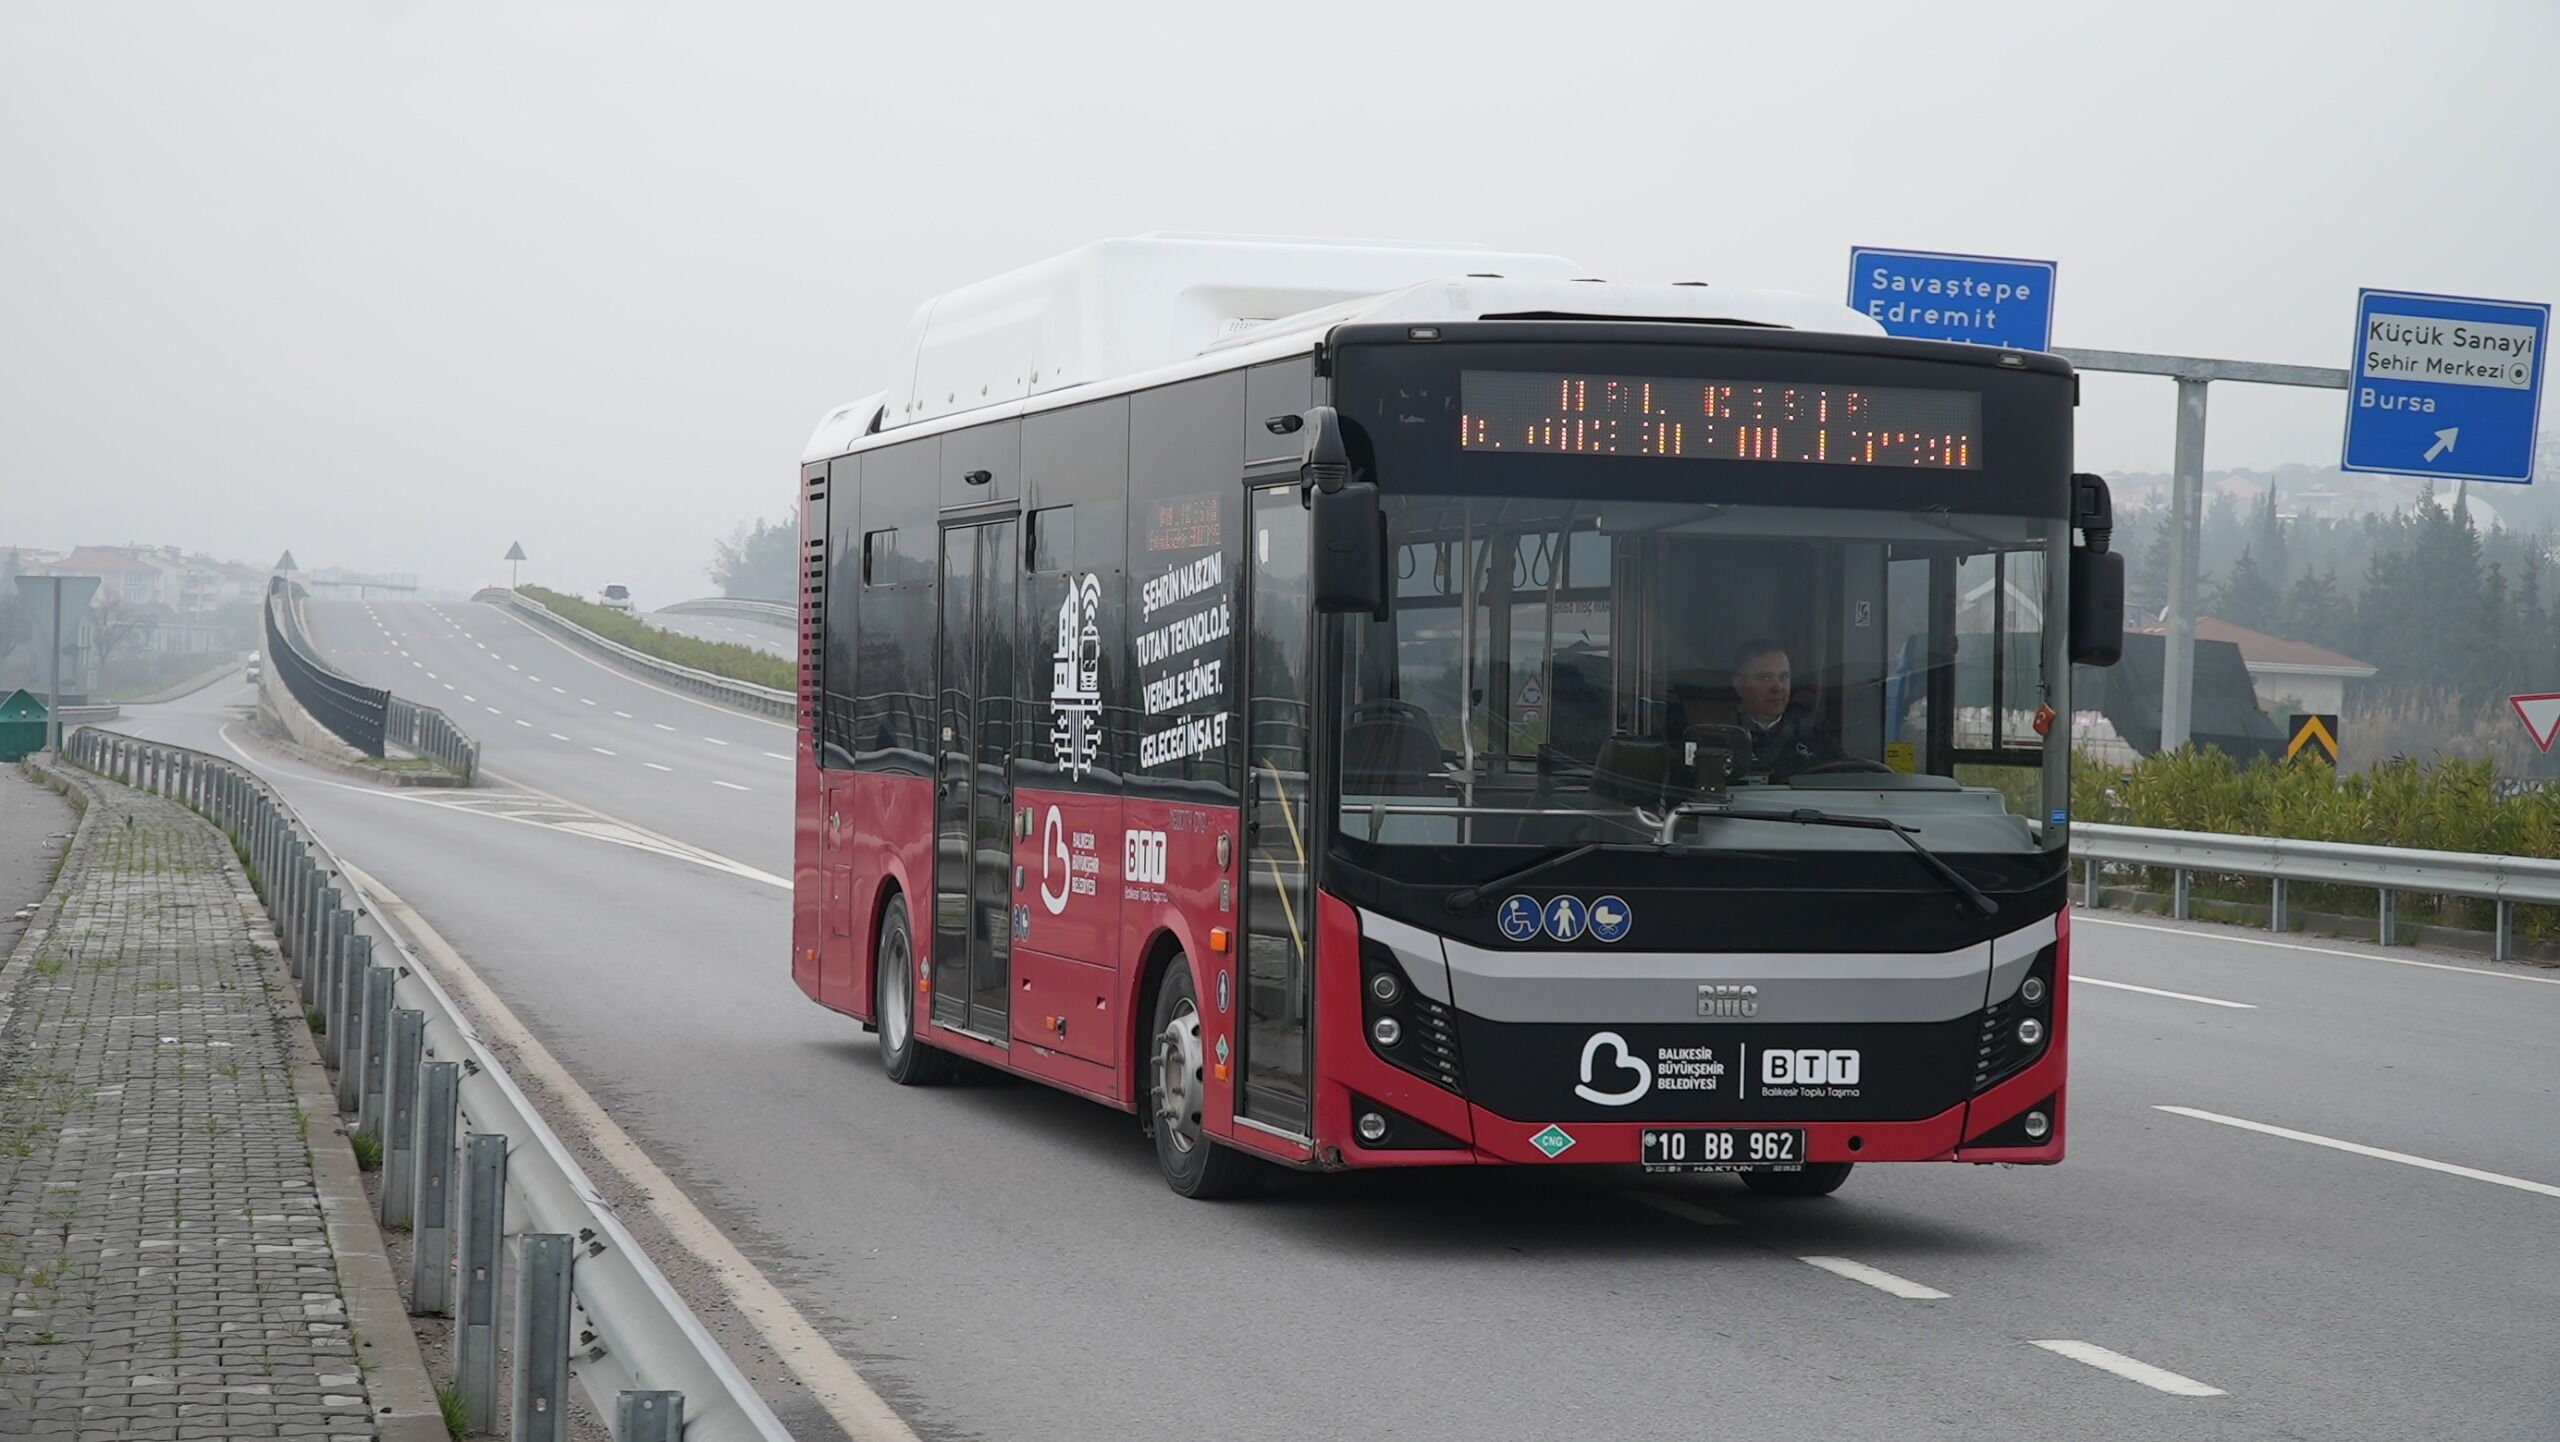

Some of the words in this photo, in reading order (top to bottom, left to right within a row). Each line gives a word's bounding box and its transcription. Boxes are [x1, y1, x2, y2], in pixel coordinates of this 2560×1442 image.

[1872, 268, 2031, 304] Savaştepe
[1869, 300, 1996, 329] Edremit
[2369, 321, 2444, 347] Küçük
[2453, 327, 2533, 357] Sanayi
[2367, 352, 2419, 371] Şehir
[2426, 357, 2505, 379] Merkezi
[2360, 387, 2436, 413] Bursa
[1143, 563, 1180, 623] ŞEHRİN
[1180, 550, 1222, 600] NABZINI
[1136, 626, 1169, 668] TUTAN
[1143, 670, 1185, 716] VERİYLE
[1140, 714, 1186, 769] GELECEĞİ
[1187, 714, 1213, 762] İNŞA
[1214, 711, 1228, 747] ET
[1697, 984, 1758, 1018] BMC
[1658, 1046, 1713, 1060] BALIKESİR
[1658, 1060, 1725, 1077] BÜYÜKŞEHİR
[1658, 1075, 1717, 1090] BELEDİYESİ
[1761, 1087, 1799, 1097] Balıkesir
[1800, 1087, 1825, 1098] Toplu
[1827, 1087, 1860, 1098] Taşıma
[1542, 1135, 1564, 1147] CNG
[1659, 1132, 1686, 1160] 10
[1705, 1132, 1733, 1160] BB
[1750, 1132, 1793, 1160] 962
